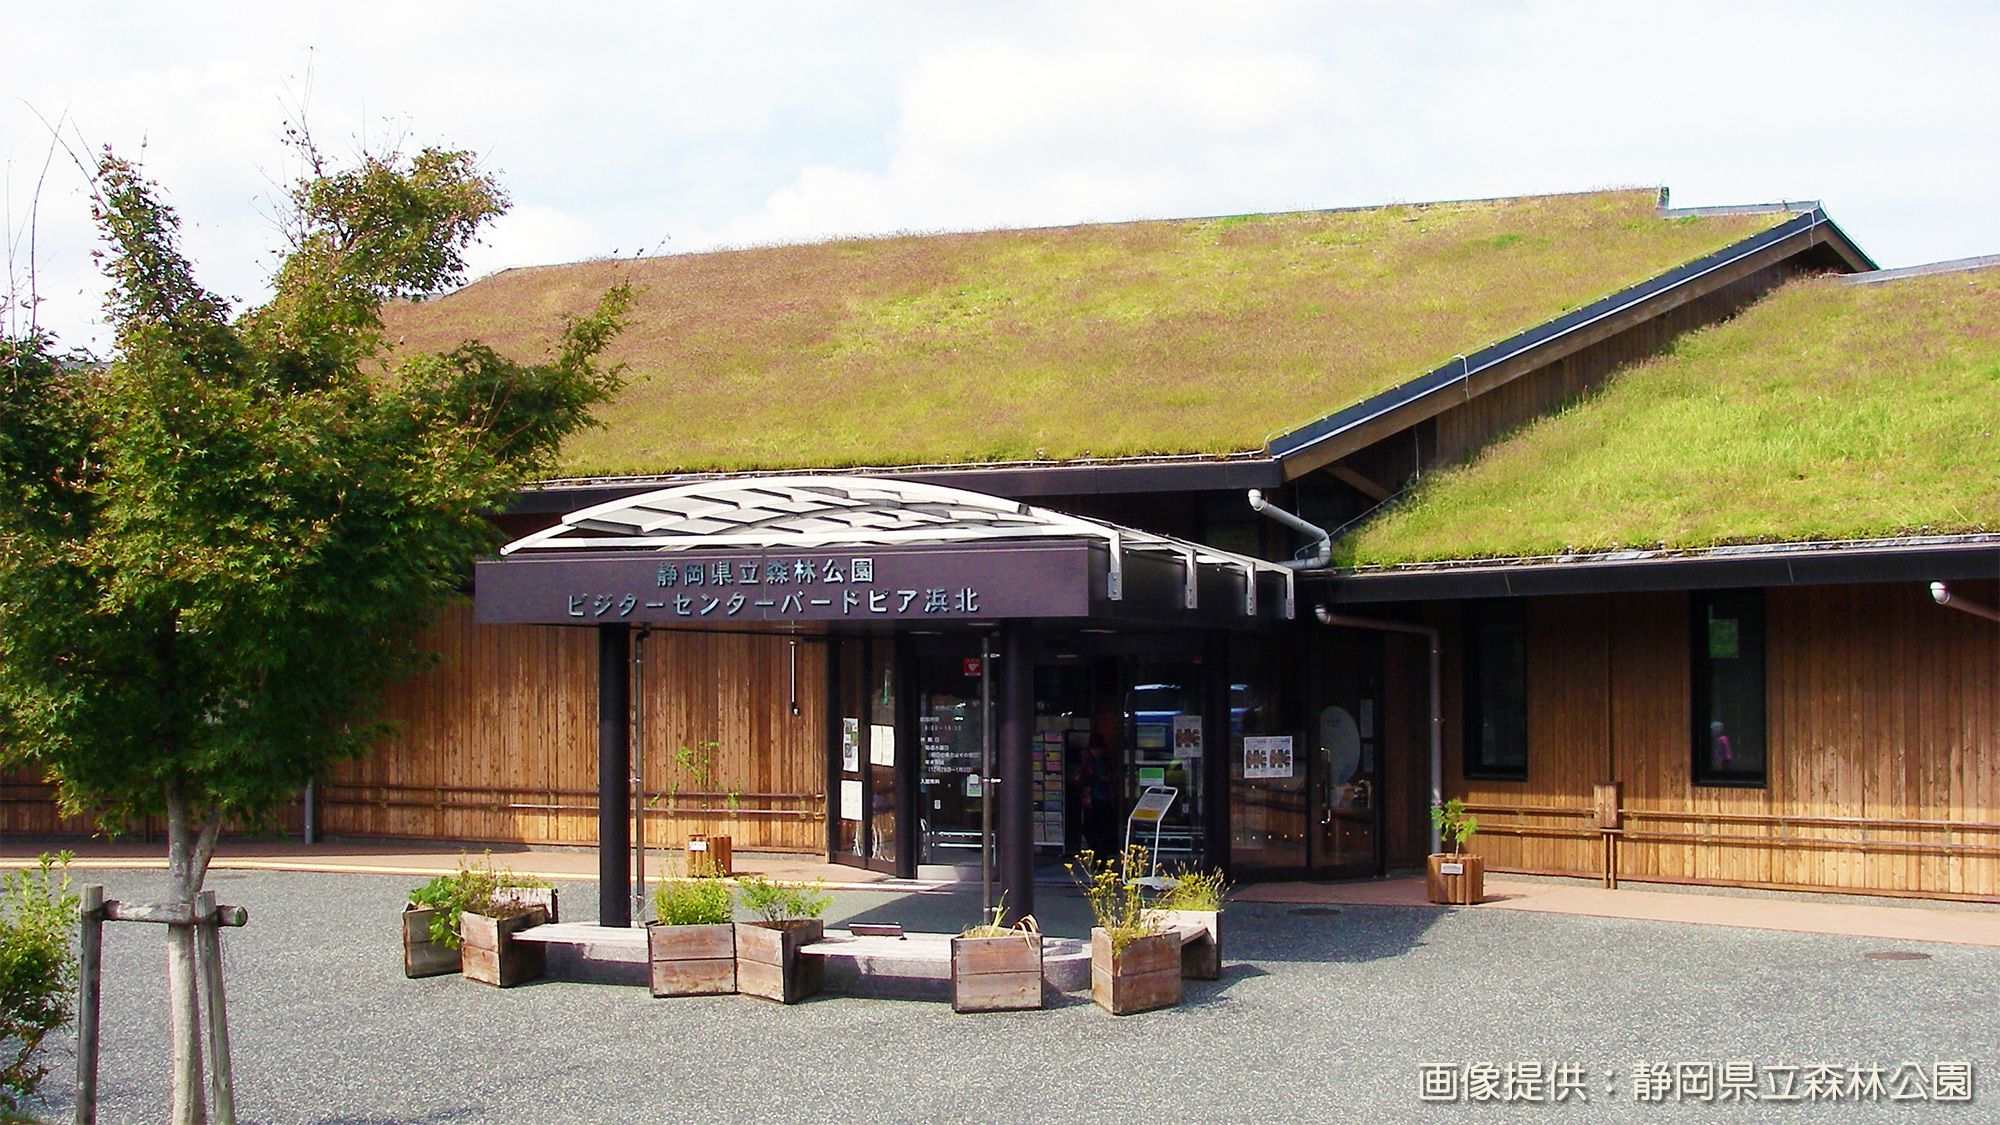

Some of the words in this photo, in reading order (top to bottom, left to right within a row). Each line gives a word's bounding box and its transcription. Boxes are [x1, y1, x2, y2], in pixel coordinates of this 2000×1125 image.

[657, 557, 874, 587] 静岡県立森林公園
[568, 588, 980, 617] ビジターセンターバードピア浜北
